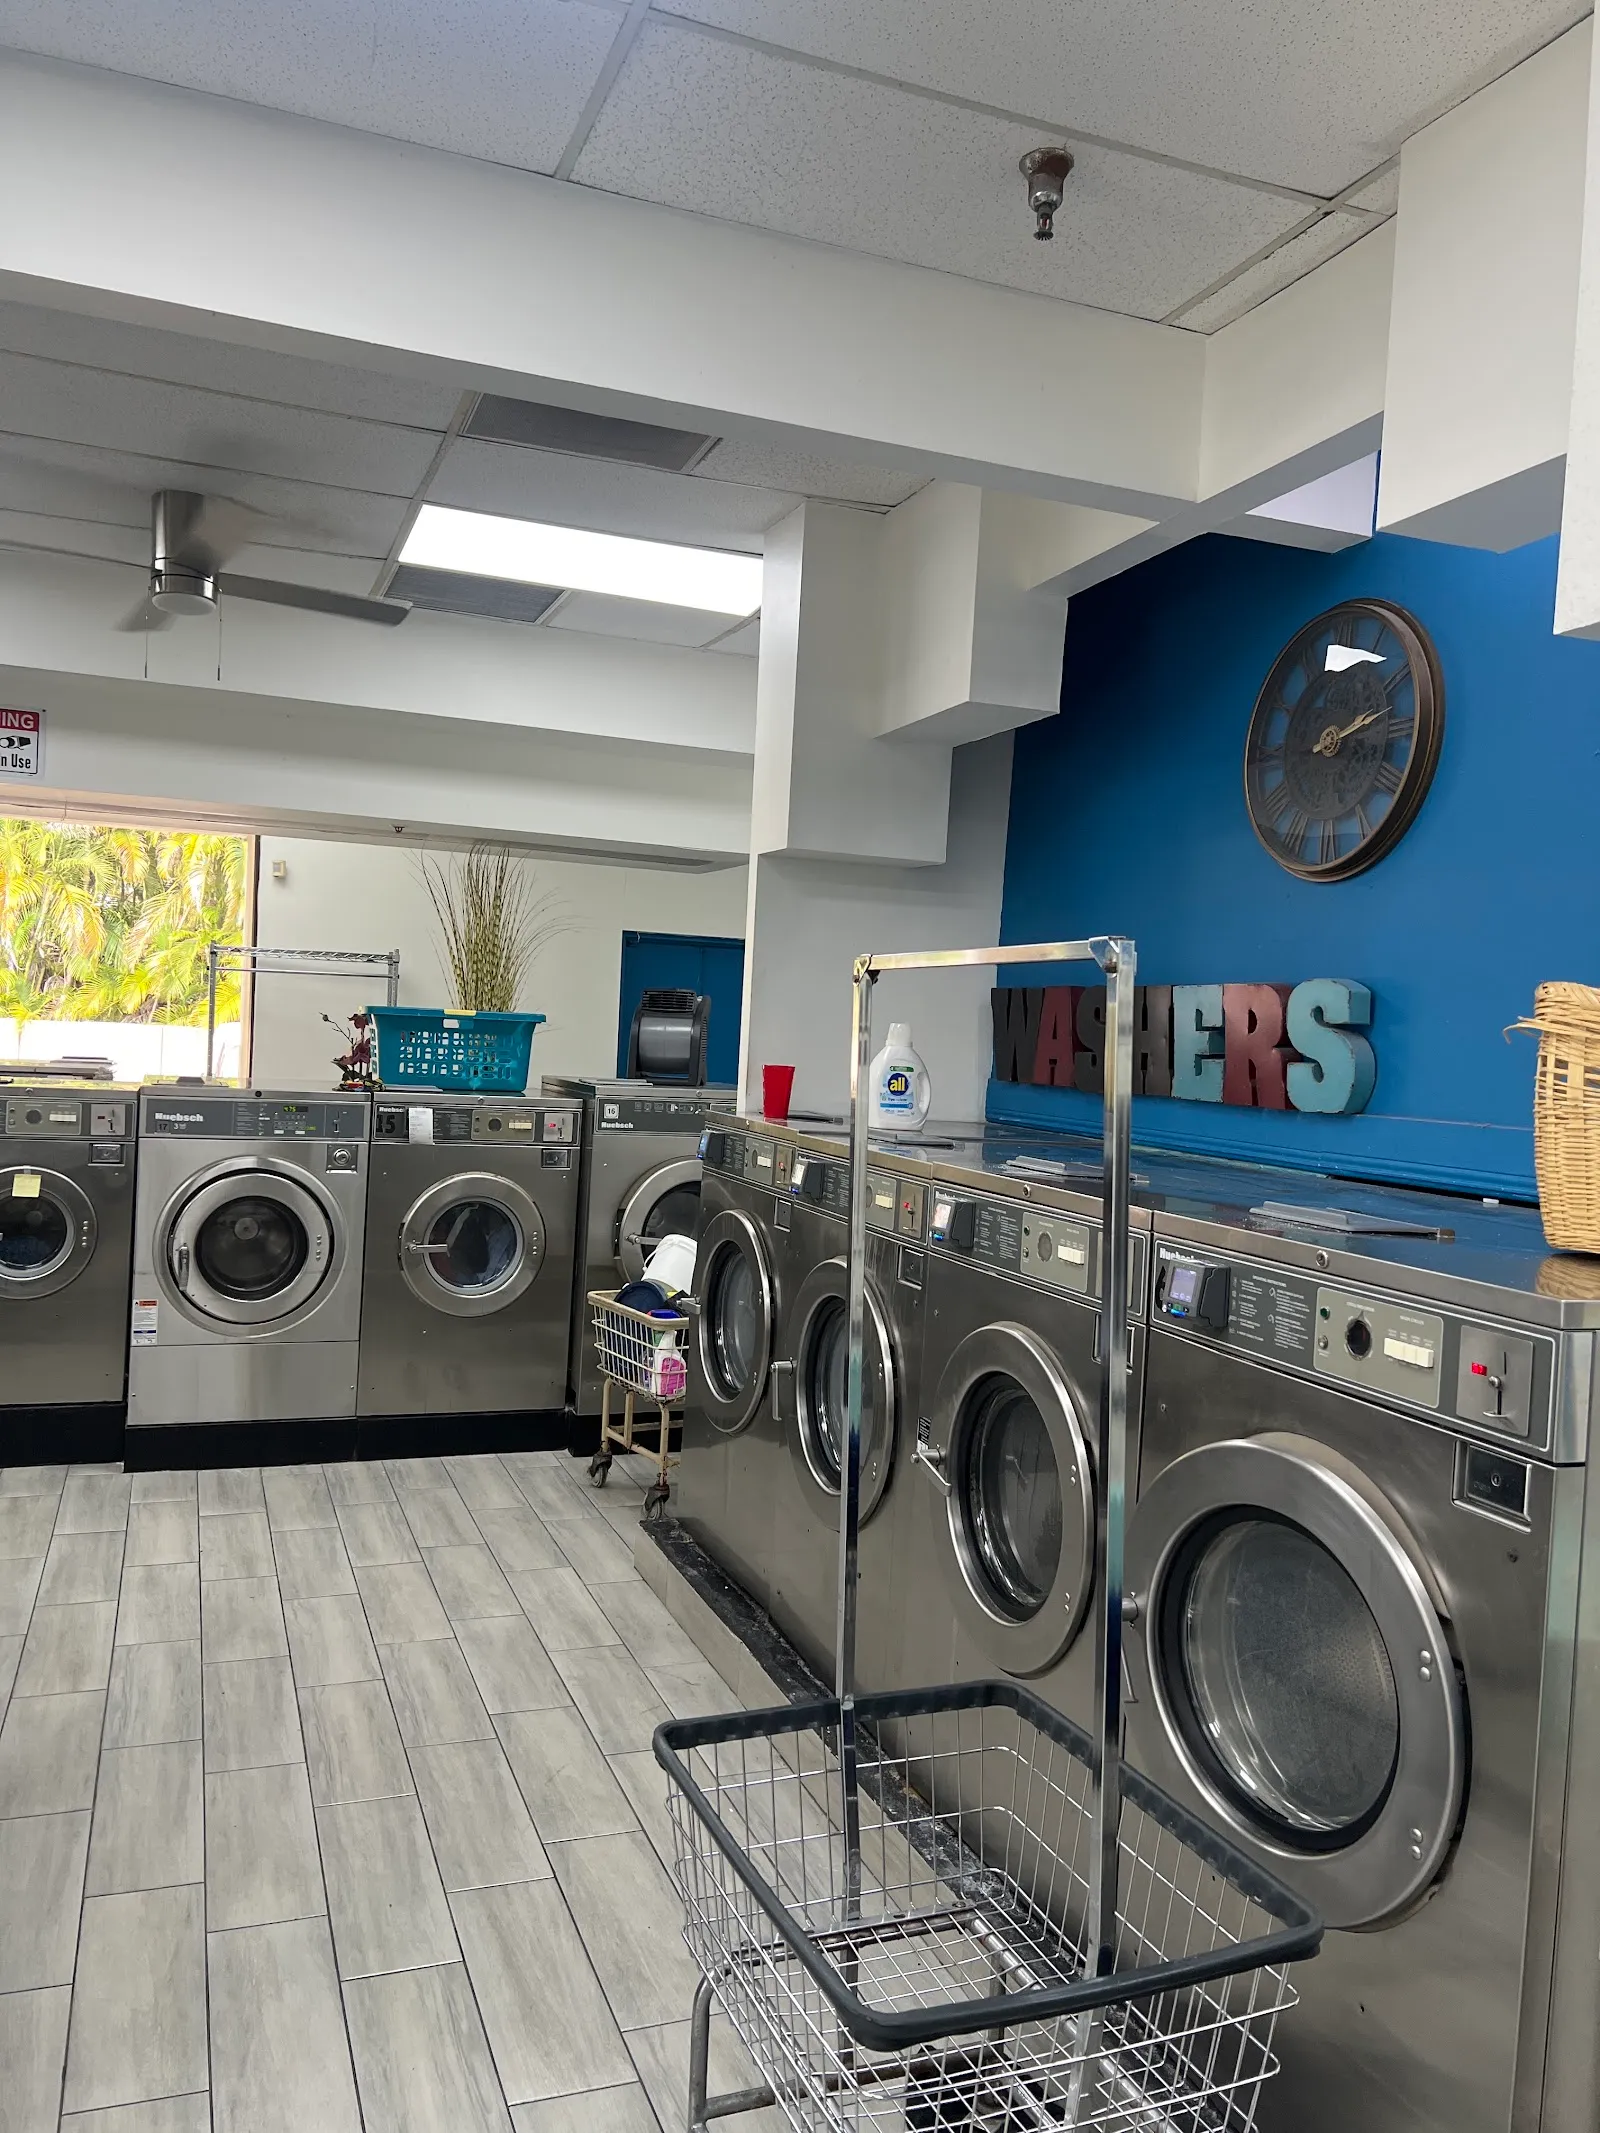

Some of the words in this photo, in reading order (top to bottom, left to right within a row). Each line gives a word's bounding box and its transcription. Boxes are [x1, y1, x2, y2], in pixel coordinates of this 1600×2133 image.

[1, 711, 34, 729] ING
[11, 753, 31, 769] Use
[990, 977, 1377, 1115] WASHERS
[889, 1076, 906, 1092] all
[154, 1112, 204, 1122] Huebsch
[607, 1108, 616, 1116] 16
[601, 1121, 634, 1129] Huebsch
